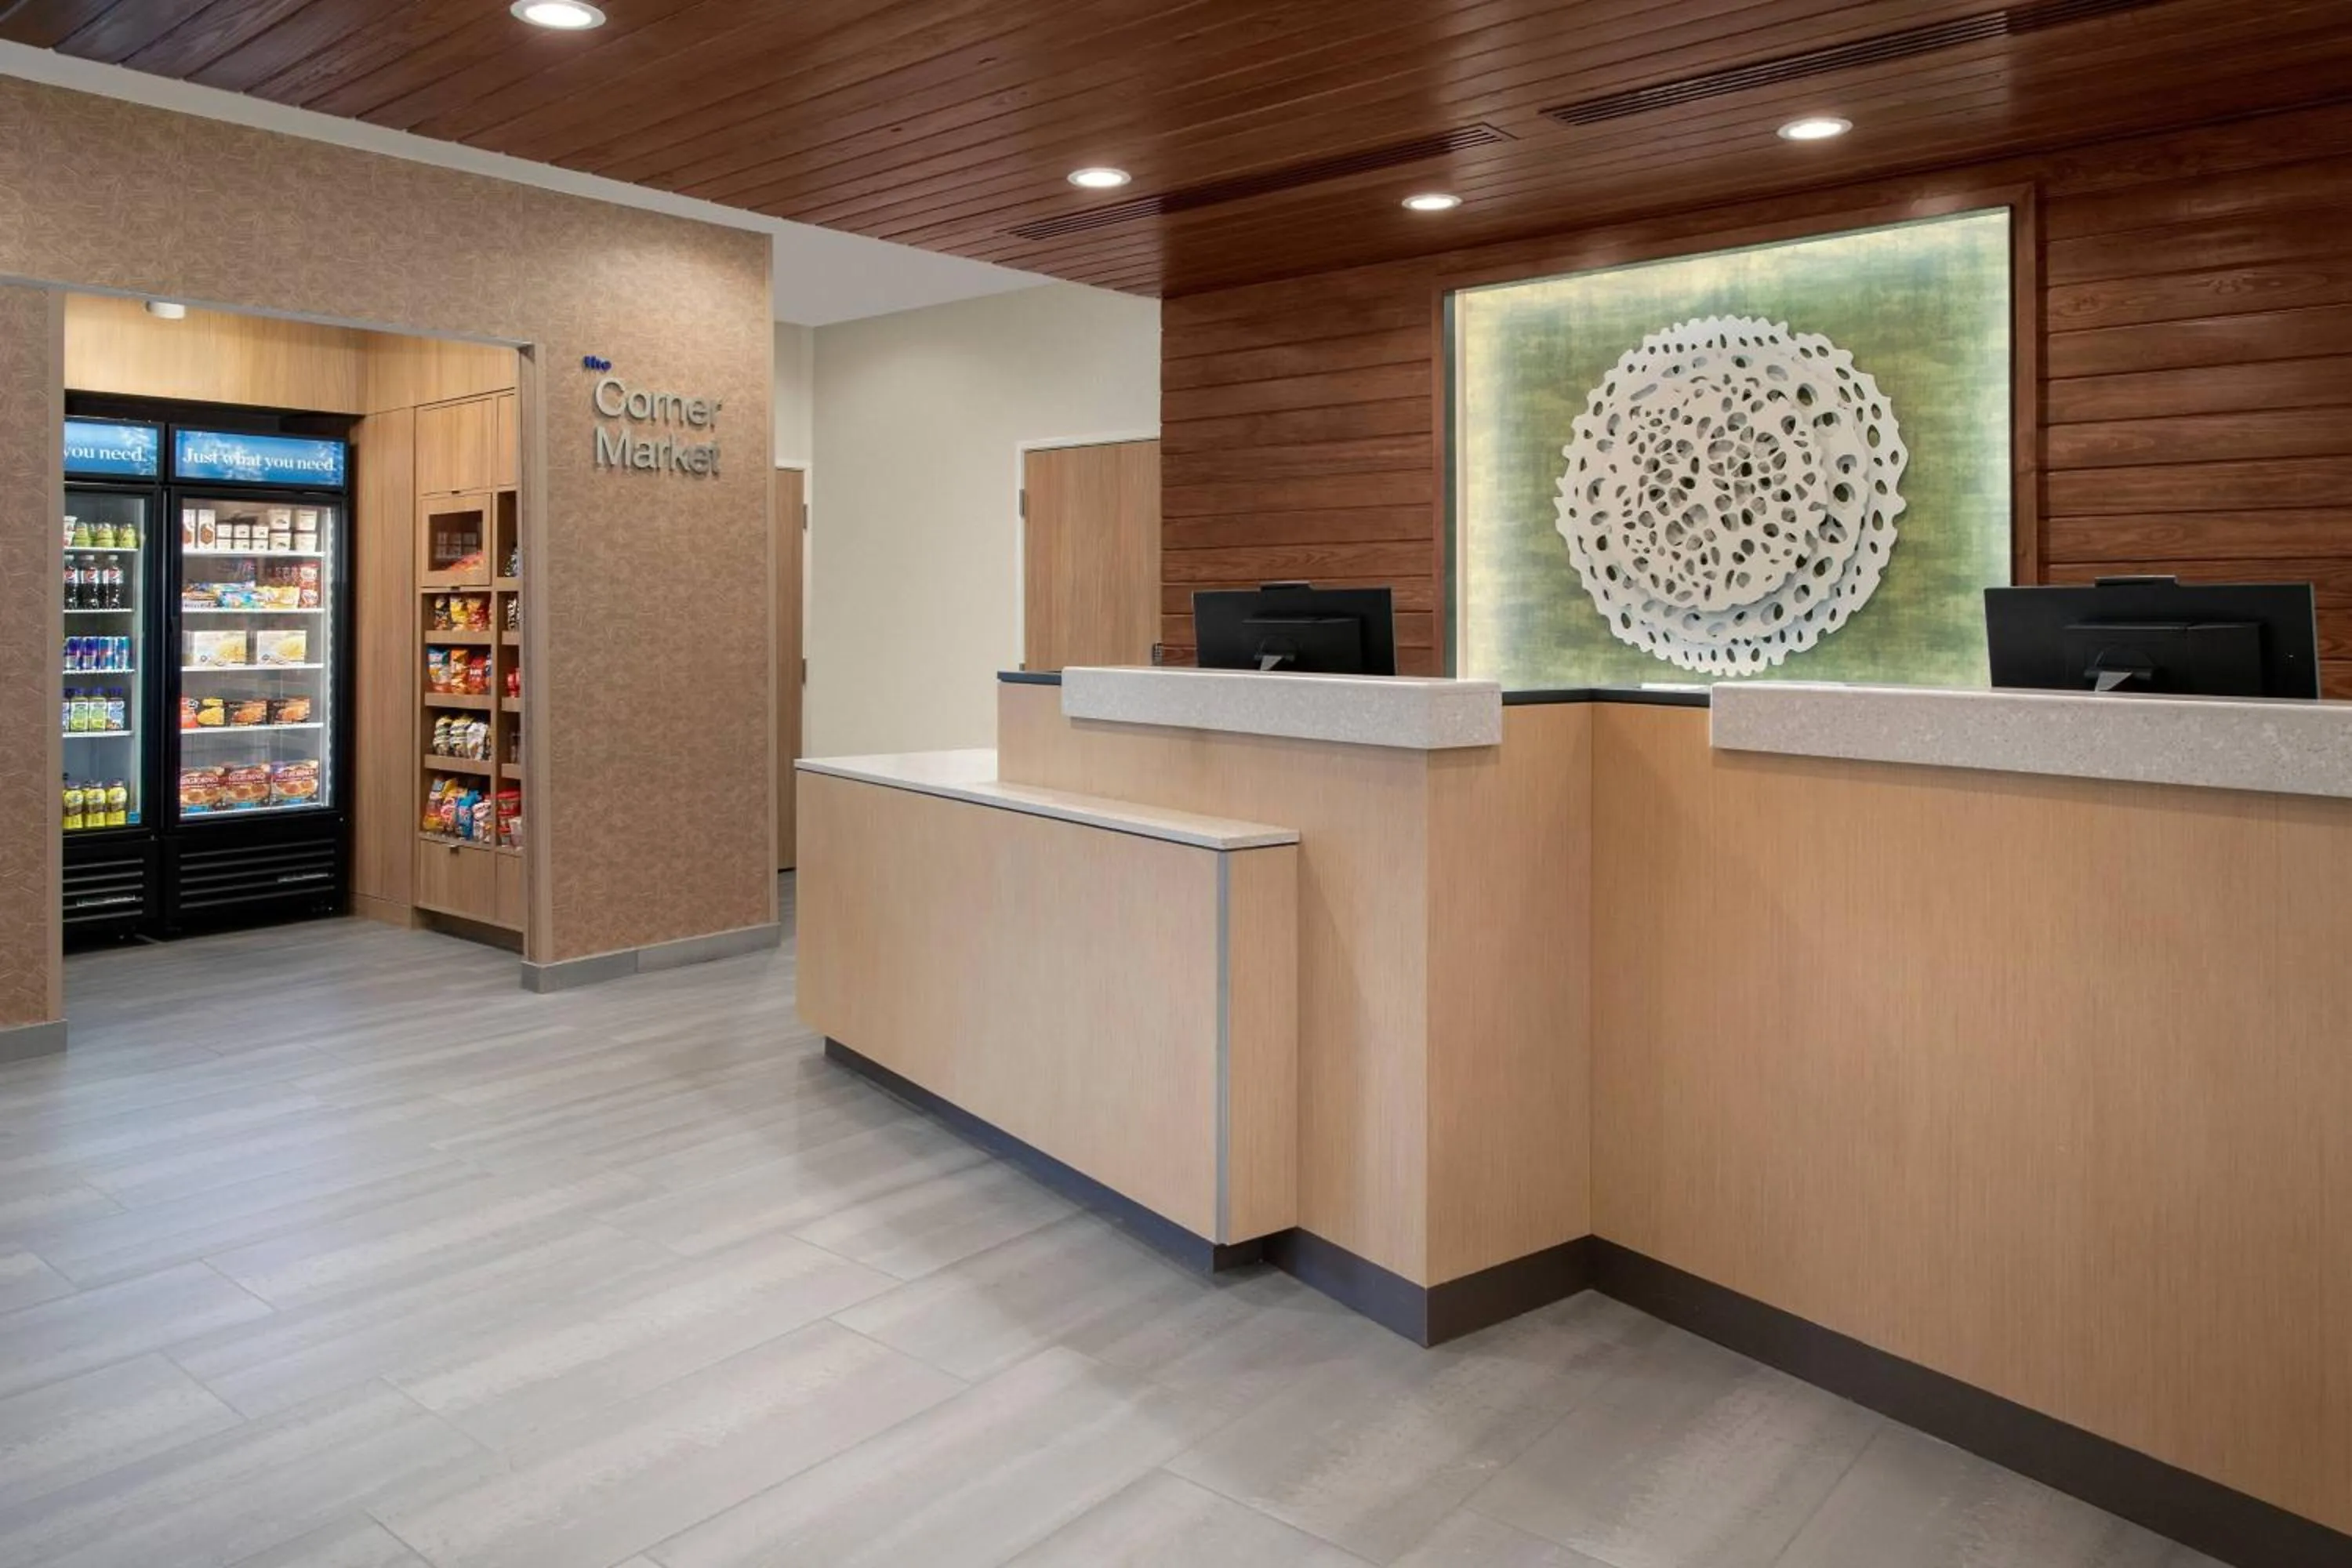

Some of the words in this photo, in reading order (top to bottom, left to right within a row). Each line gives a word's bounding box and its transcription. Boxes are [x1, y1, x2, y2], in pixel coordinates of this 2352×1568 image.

[583, 355, 612, 371] the
[595, 377, 722, 428] Corner
[183, 448, 219, 464] Just
[222, 450, 262, 466] what
[264, 456, 294, 471] you
[595, 426, 720, 475] Market
